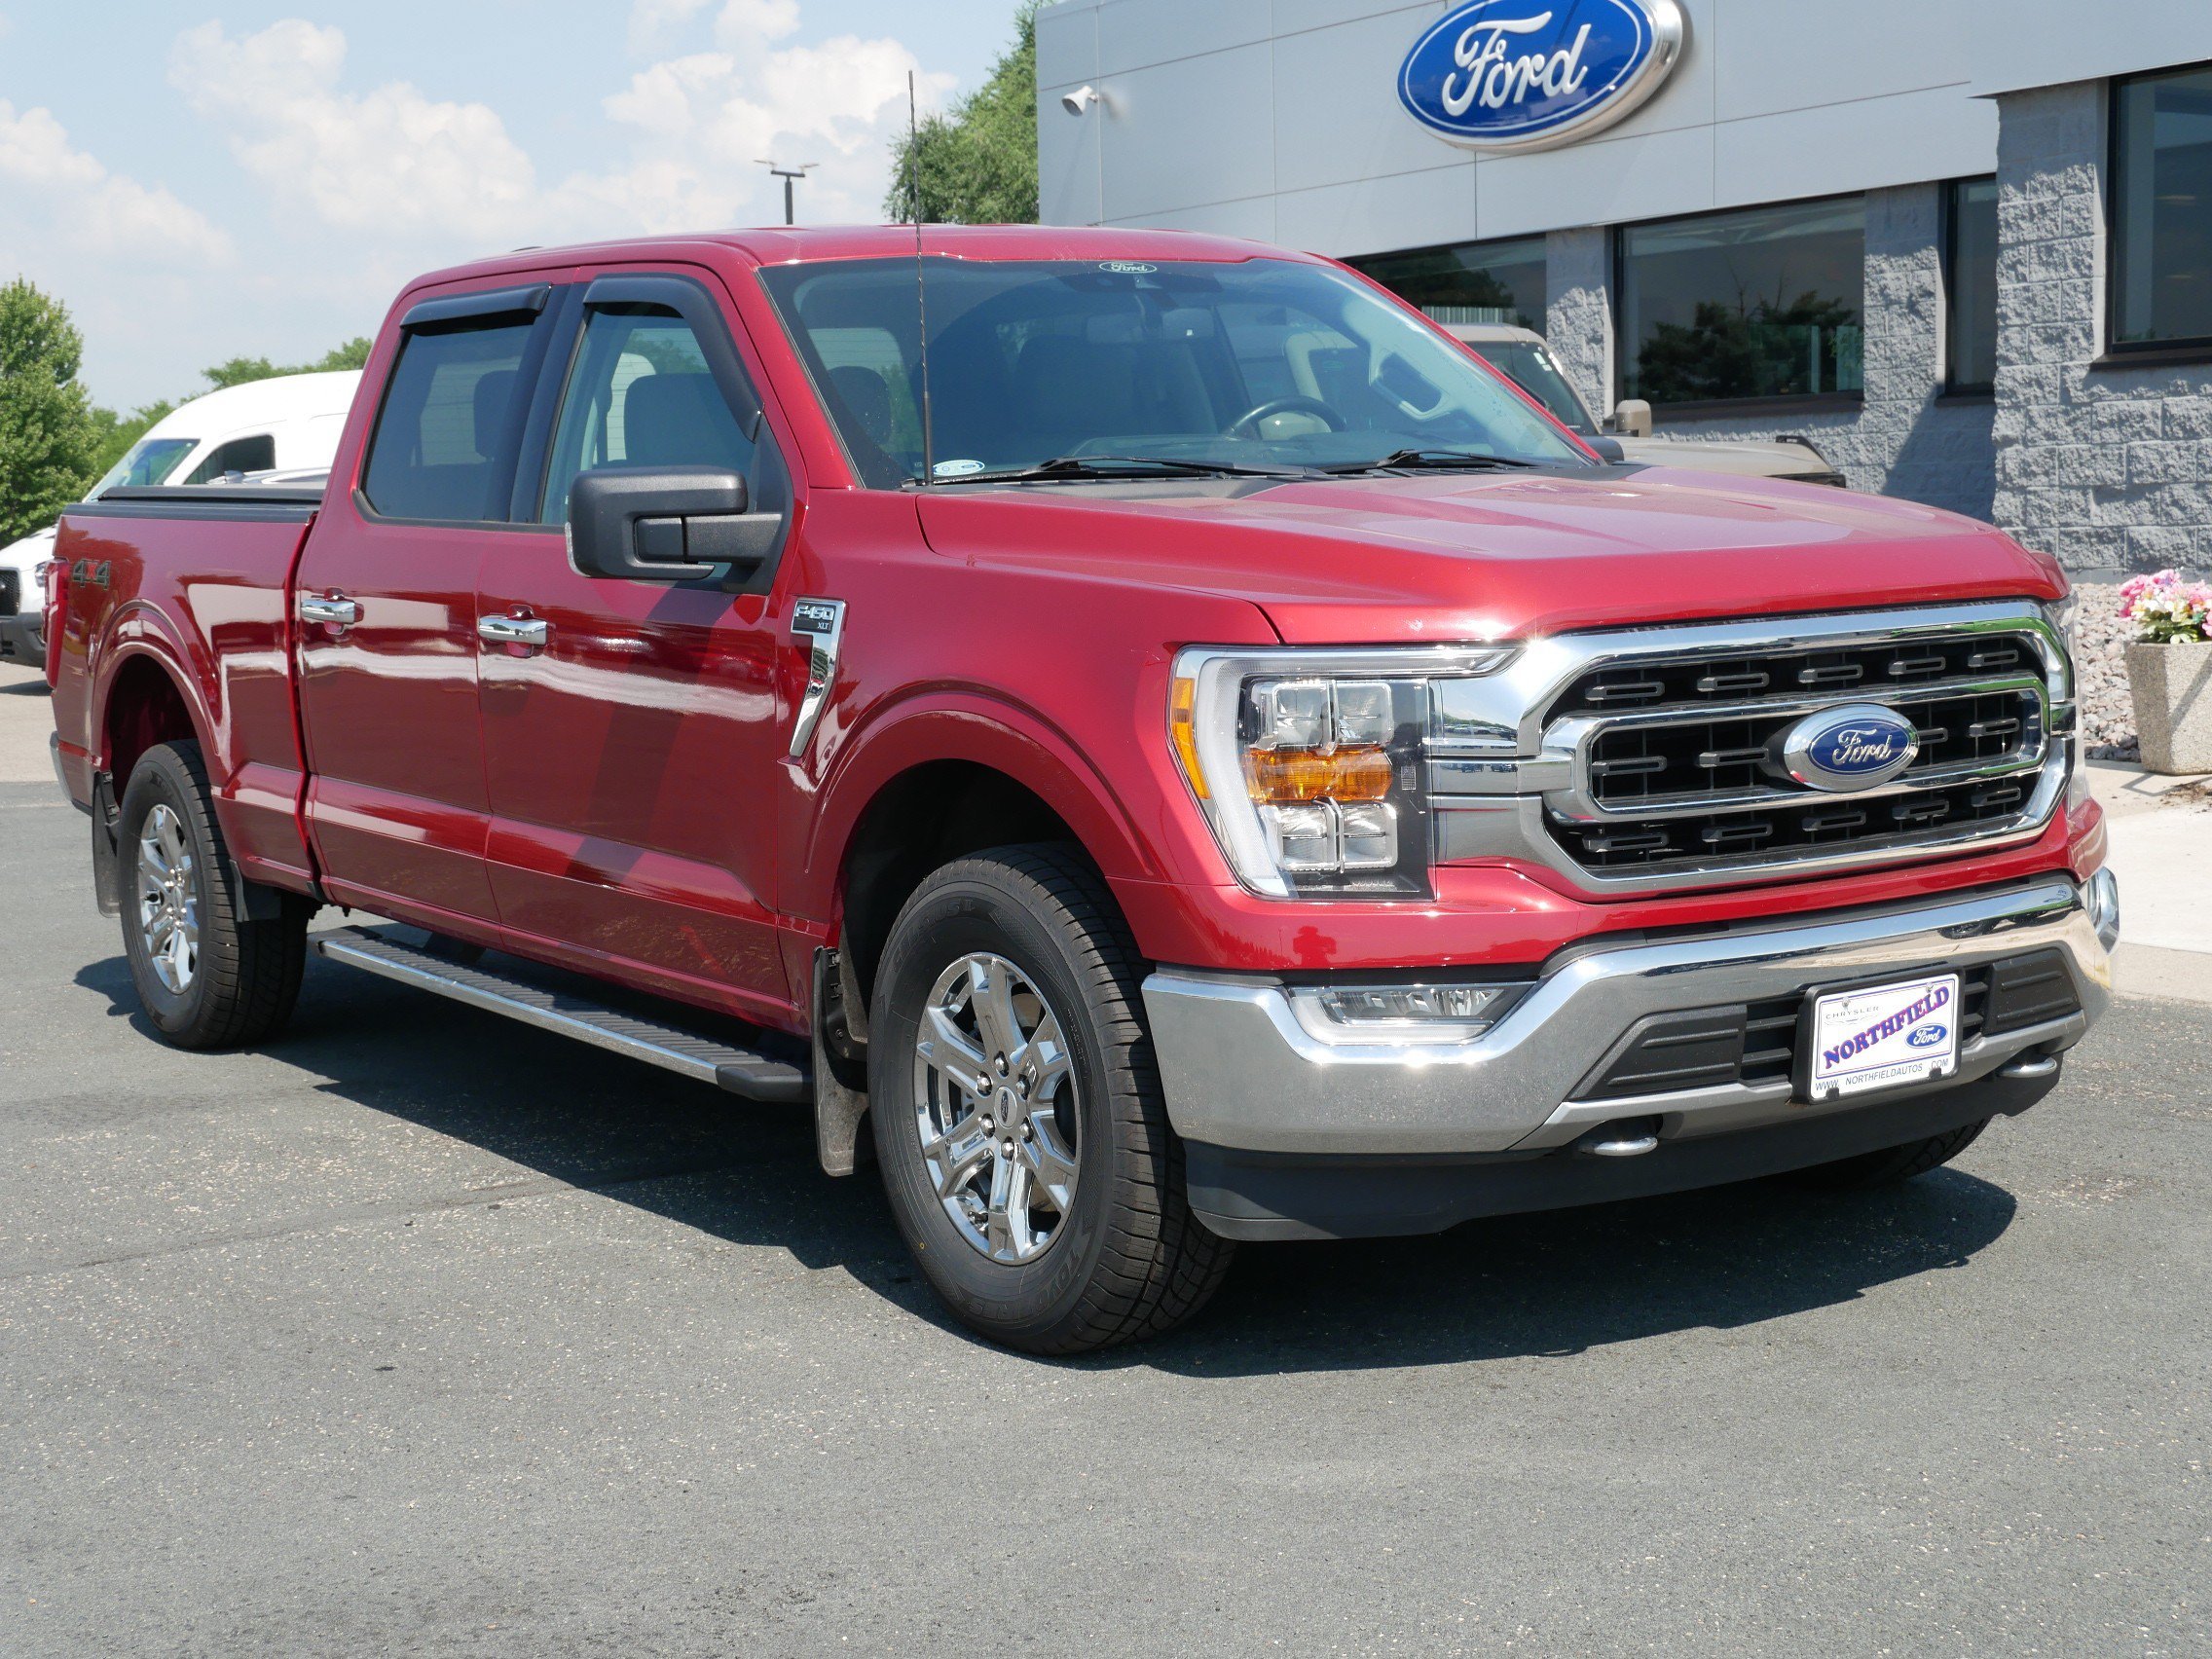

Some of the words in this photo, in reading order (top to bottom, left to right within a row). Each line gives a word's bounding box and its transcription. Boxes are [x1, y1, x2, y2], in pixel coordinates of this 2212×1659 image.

[1441, 10, 1593, 117] Ford
[1110, 262, 1148, 272] Ford
[1831, 728, 1893, 766] Ford
[1825, 1006, 1880, 1020] CHRYSLER
[1823, 986, 1950, 1069] NORTHFIELD
[1913, 1026, 1941, 1045] Ford
